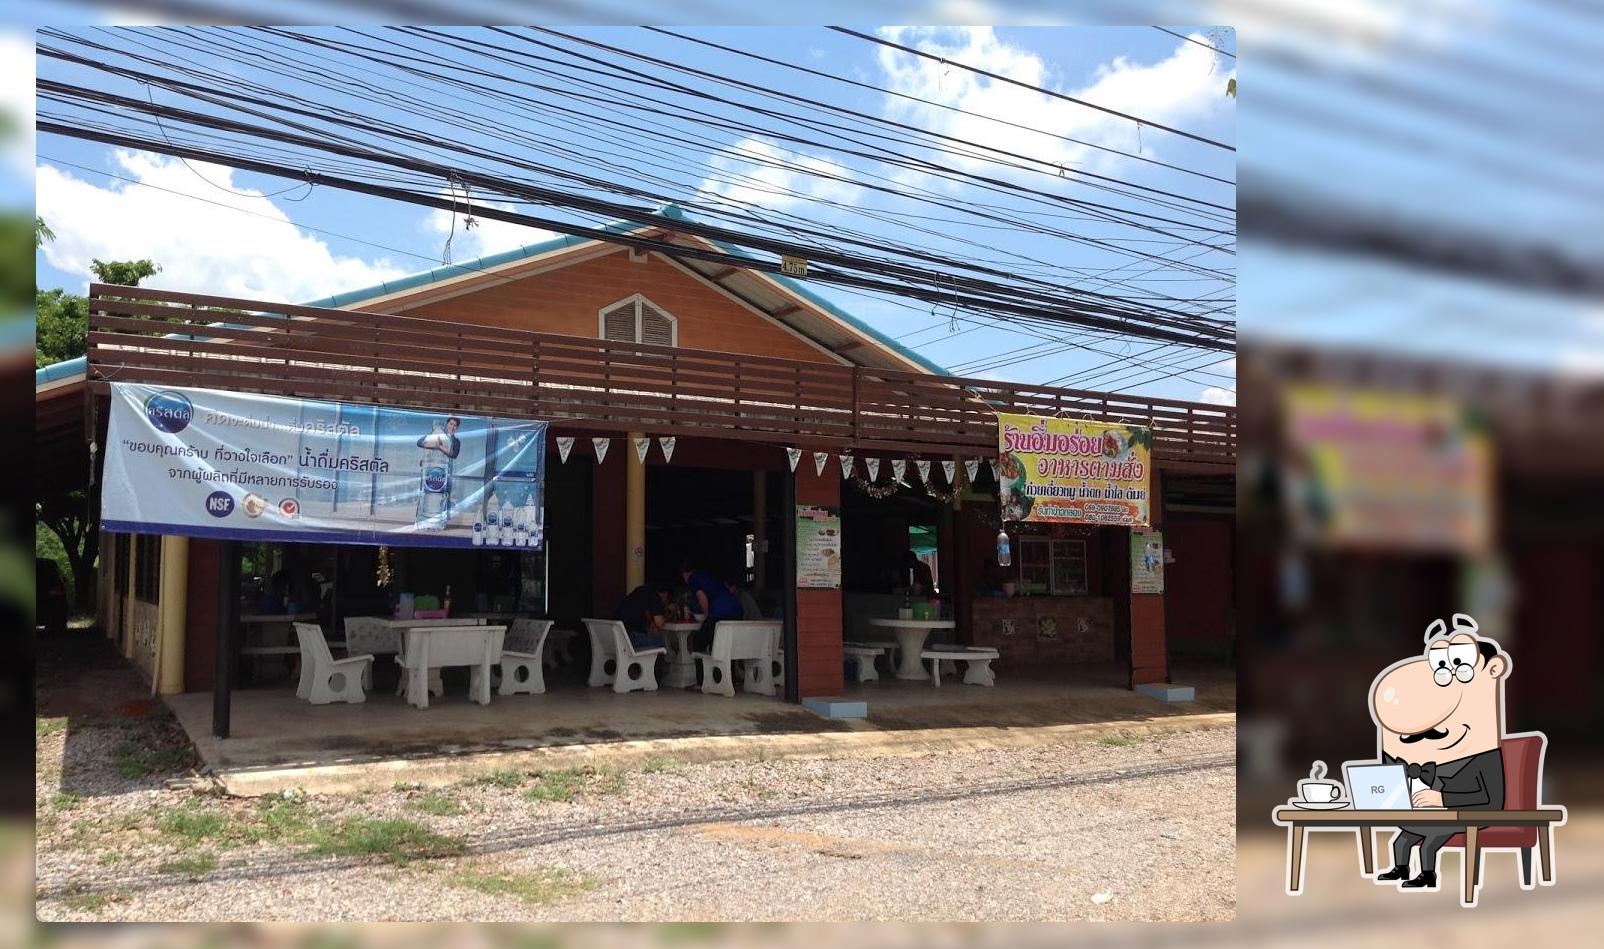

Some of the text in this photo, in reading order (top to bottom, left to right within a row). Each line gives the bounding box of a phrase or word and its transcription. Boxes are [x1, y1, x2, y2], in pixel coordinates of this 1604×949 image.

[1003, 420, 1103, 456] ร้านอิ่มอร่อย
[299, 447, 389, 473] น้ำดื่มคริสตัล
[1038, 451, 1145, 481] อาหารตามสั่ง
[208, 496, 231, 512] NSF
